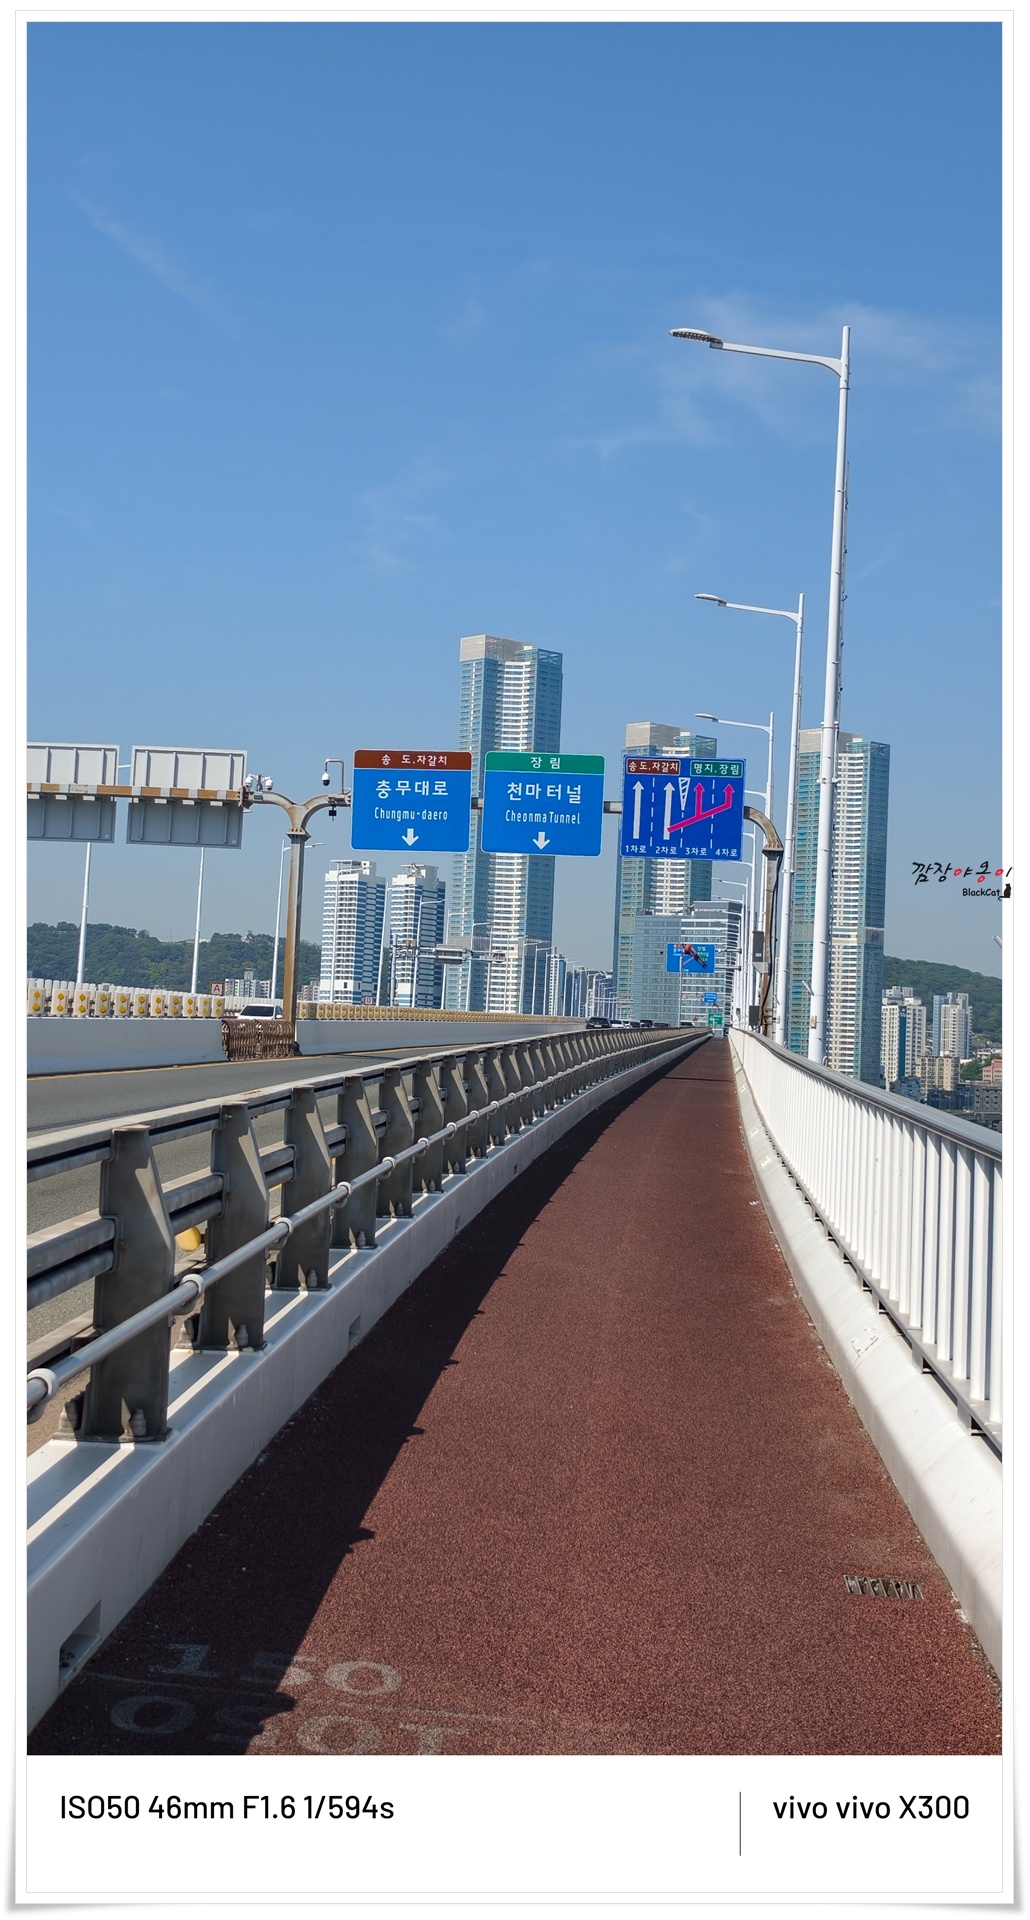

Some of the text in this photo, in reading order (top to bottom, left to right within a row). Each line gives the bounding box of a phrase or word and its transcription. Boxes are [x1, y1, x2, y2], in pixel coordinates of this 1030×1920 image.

[376, 780, 448, 799] 충무대로
[507, 782, 581, 804] 천마터널
[374, 807, 448, 822] Chungmu-daero
[505, 810, 580, 824] Cheonma Tunnel
[625, 845, 646, 853] 1차로
[655, 846, 677, 855] 2차로
[685, 847, 707, 856] 3차로
[715, 848, 738, 857] 4차로
[148, 1643, 401, 1696] 150
